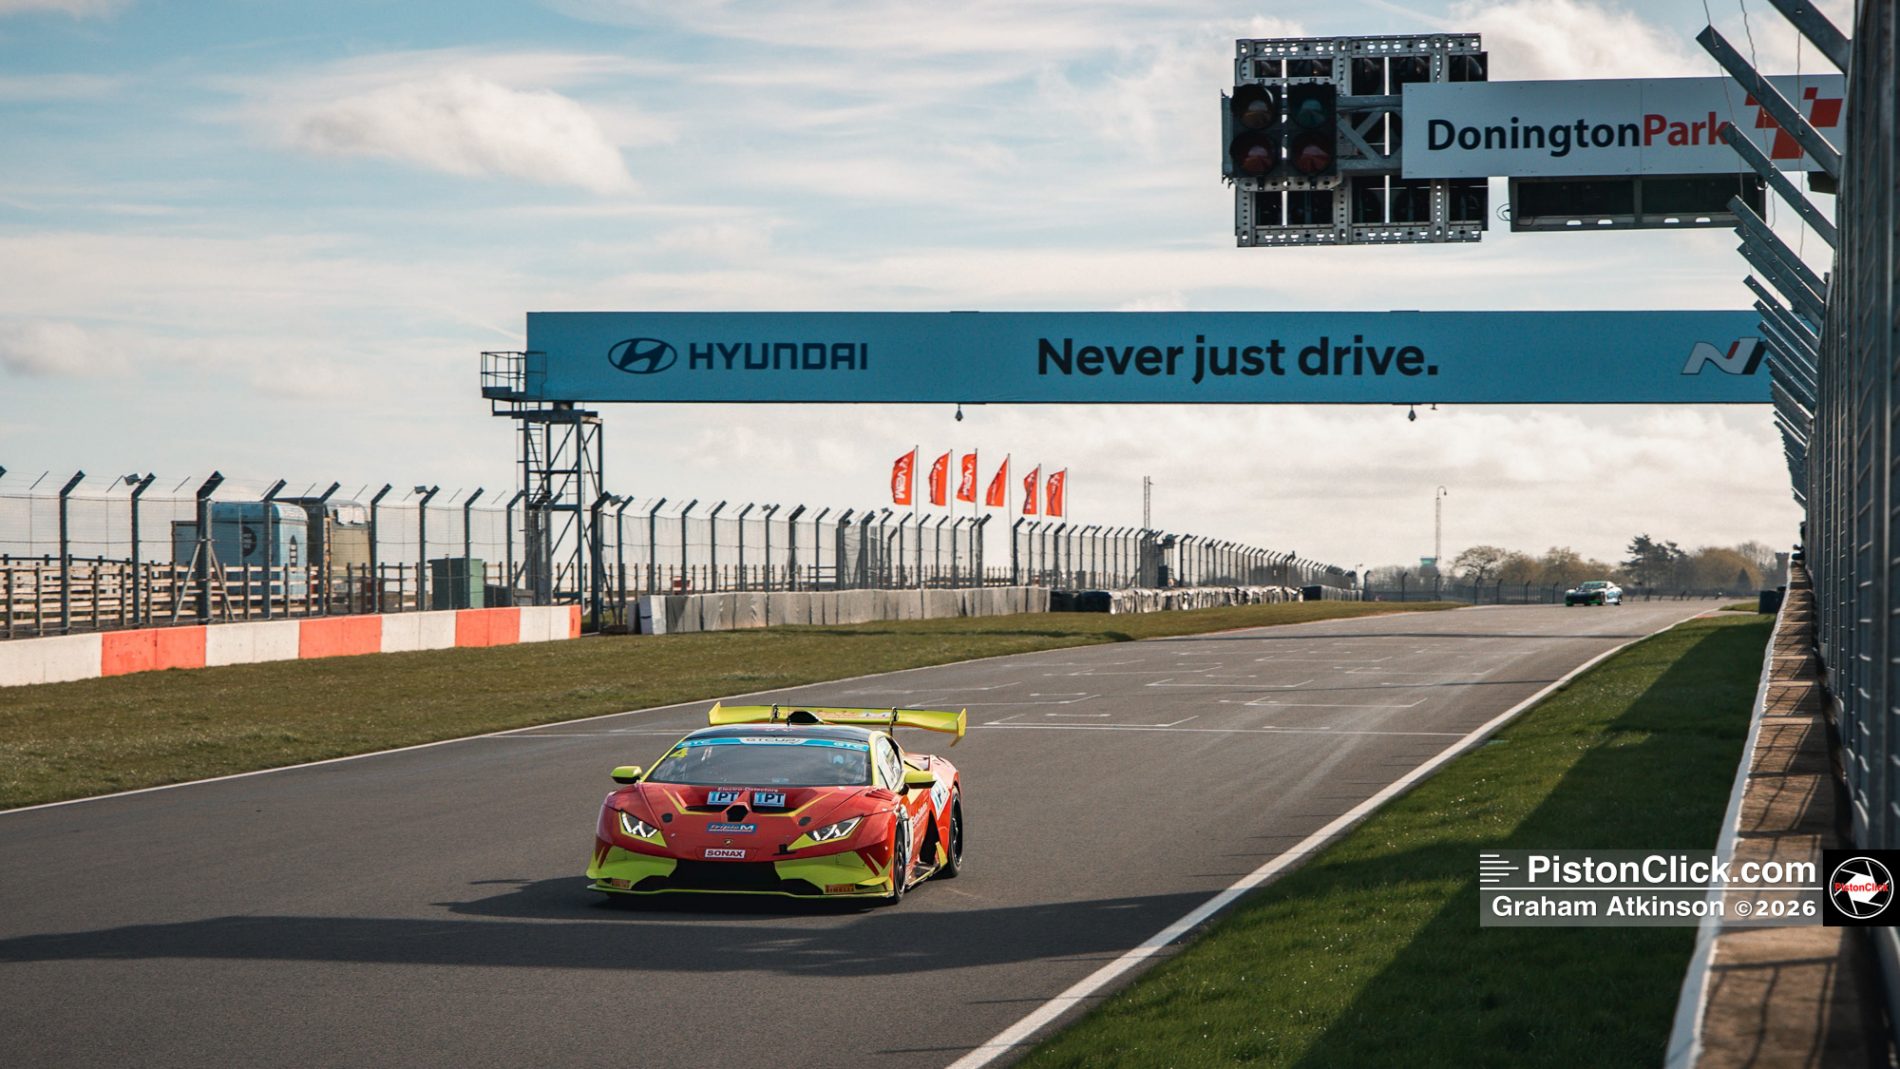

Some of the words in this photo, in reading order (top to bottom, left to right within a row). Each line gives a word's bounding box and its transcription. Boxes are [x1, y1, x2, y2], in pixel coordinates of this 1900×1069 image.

[1428, 111, 1729, 157] DoningtonPark
[689, 342, 868, 370] HYUNDAI
[1038, 338, 1184, 376] Never
[1192, 335, 1286, 385] just
[1297, 335, 1439, 377] drive.
